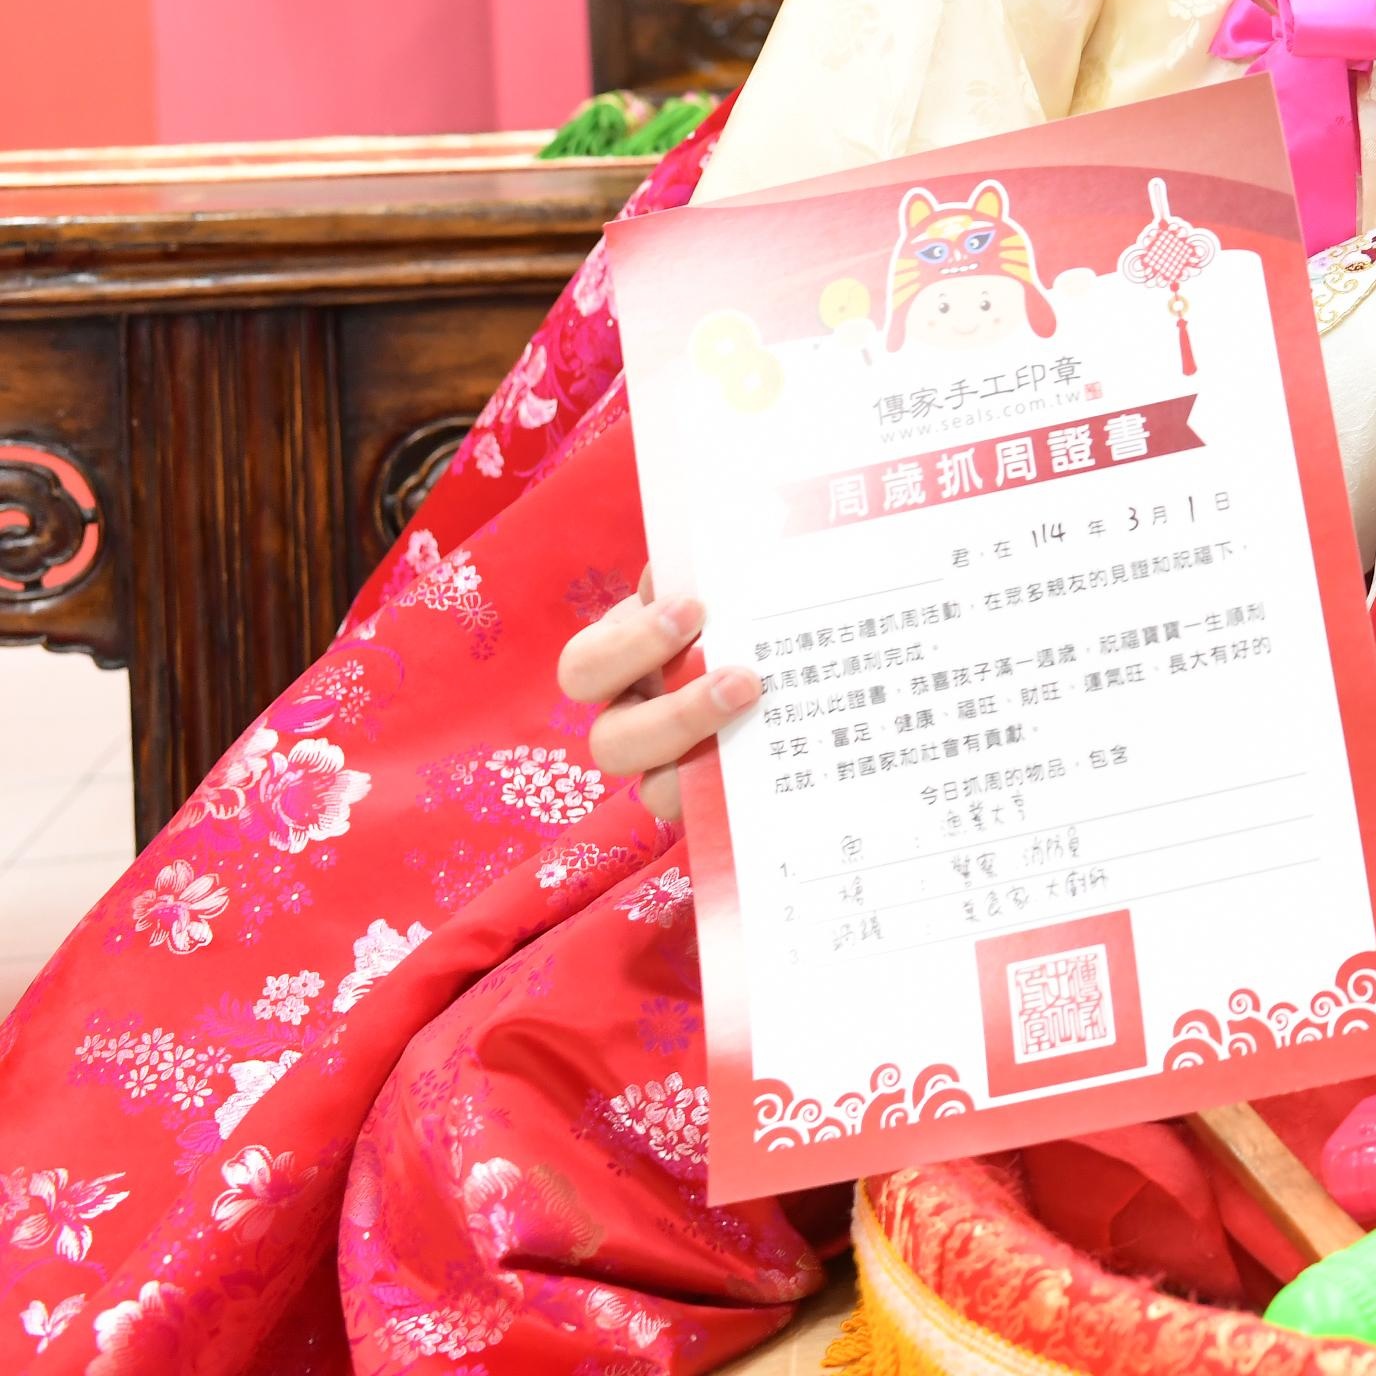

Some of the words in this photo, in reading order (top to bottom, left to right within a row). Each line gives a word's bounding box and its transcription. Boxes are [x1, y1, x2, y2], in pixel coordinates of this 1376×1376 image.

[872, 356, 1083, 424] 傳家手工印章
[880, 390, 1080, 444] www.seals.com.tw
[828, 414, 1150, 522] 周歲抓周證書
[1031, 522, 1067, 547] 114
[1087, 519, 1106, 537] 年
[1128, 506, 1140, 531] 3
[1152, 505, 1168, 526] 月
[1188, 496, 1195, 523] 1
[1214, 491, 1231, 511] 日
